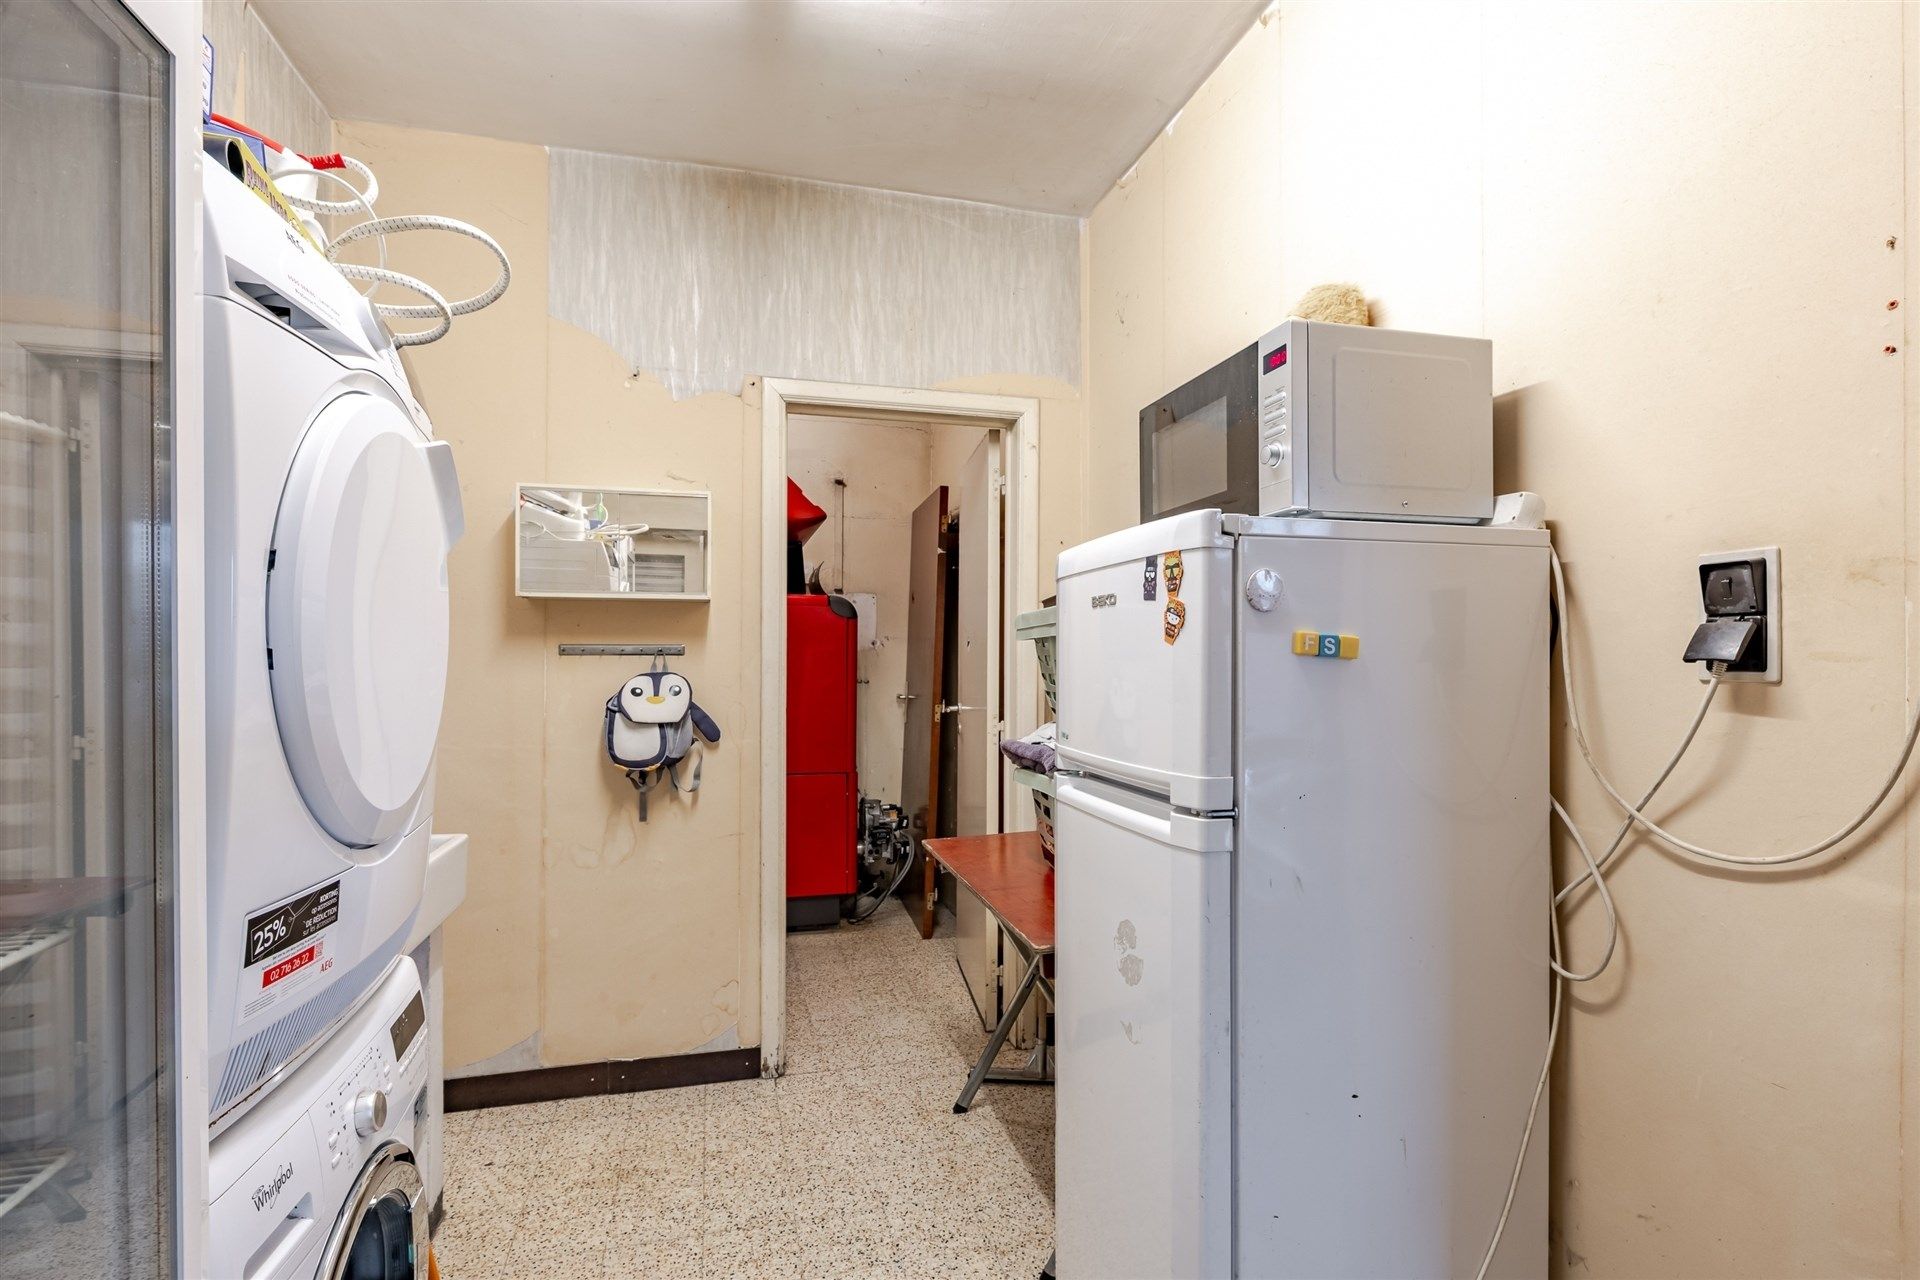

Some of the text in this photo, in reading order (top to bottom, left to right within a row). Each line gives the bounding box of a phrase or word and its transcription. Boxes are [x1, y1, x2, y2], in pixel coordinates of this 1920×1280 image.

[1091, 593, 1117, 608] BEKO
[253, 915, 287, 956] 25%
[270, 970, 280, 982] 02
[280, 961, 292, 976] 716
[301, 952, 310, 965] 22
[320, 957, 334, 973] AEG
[253, 1161, 294, 1212] Whirlpool
